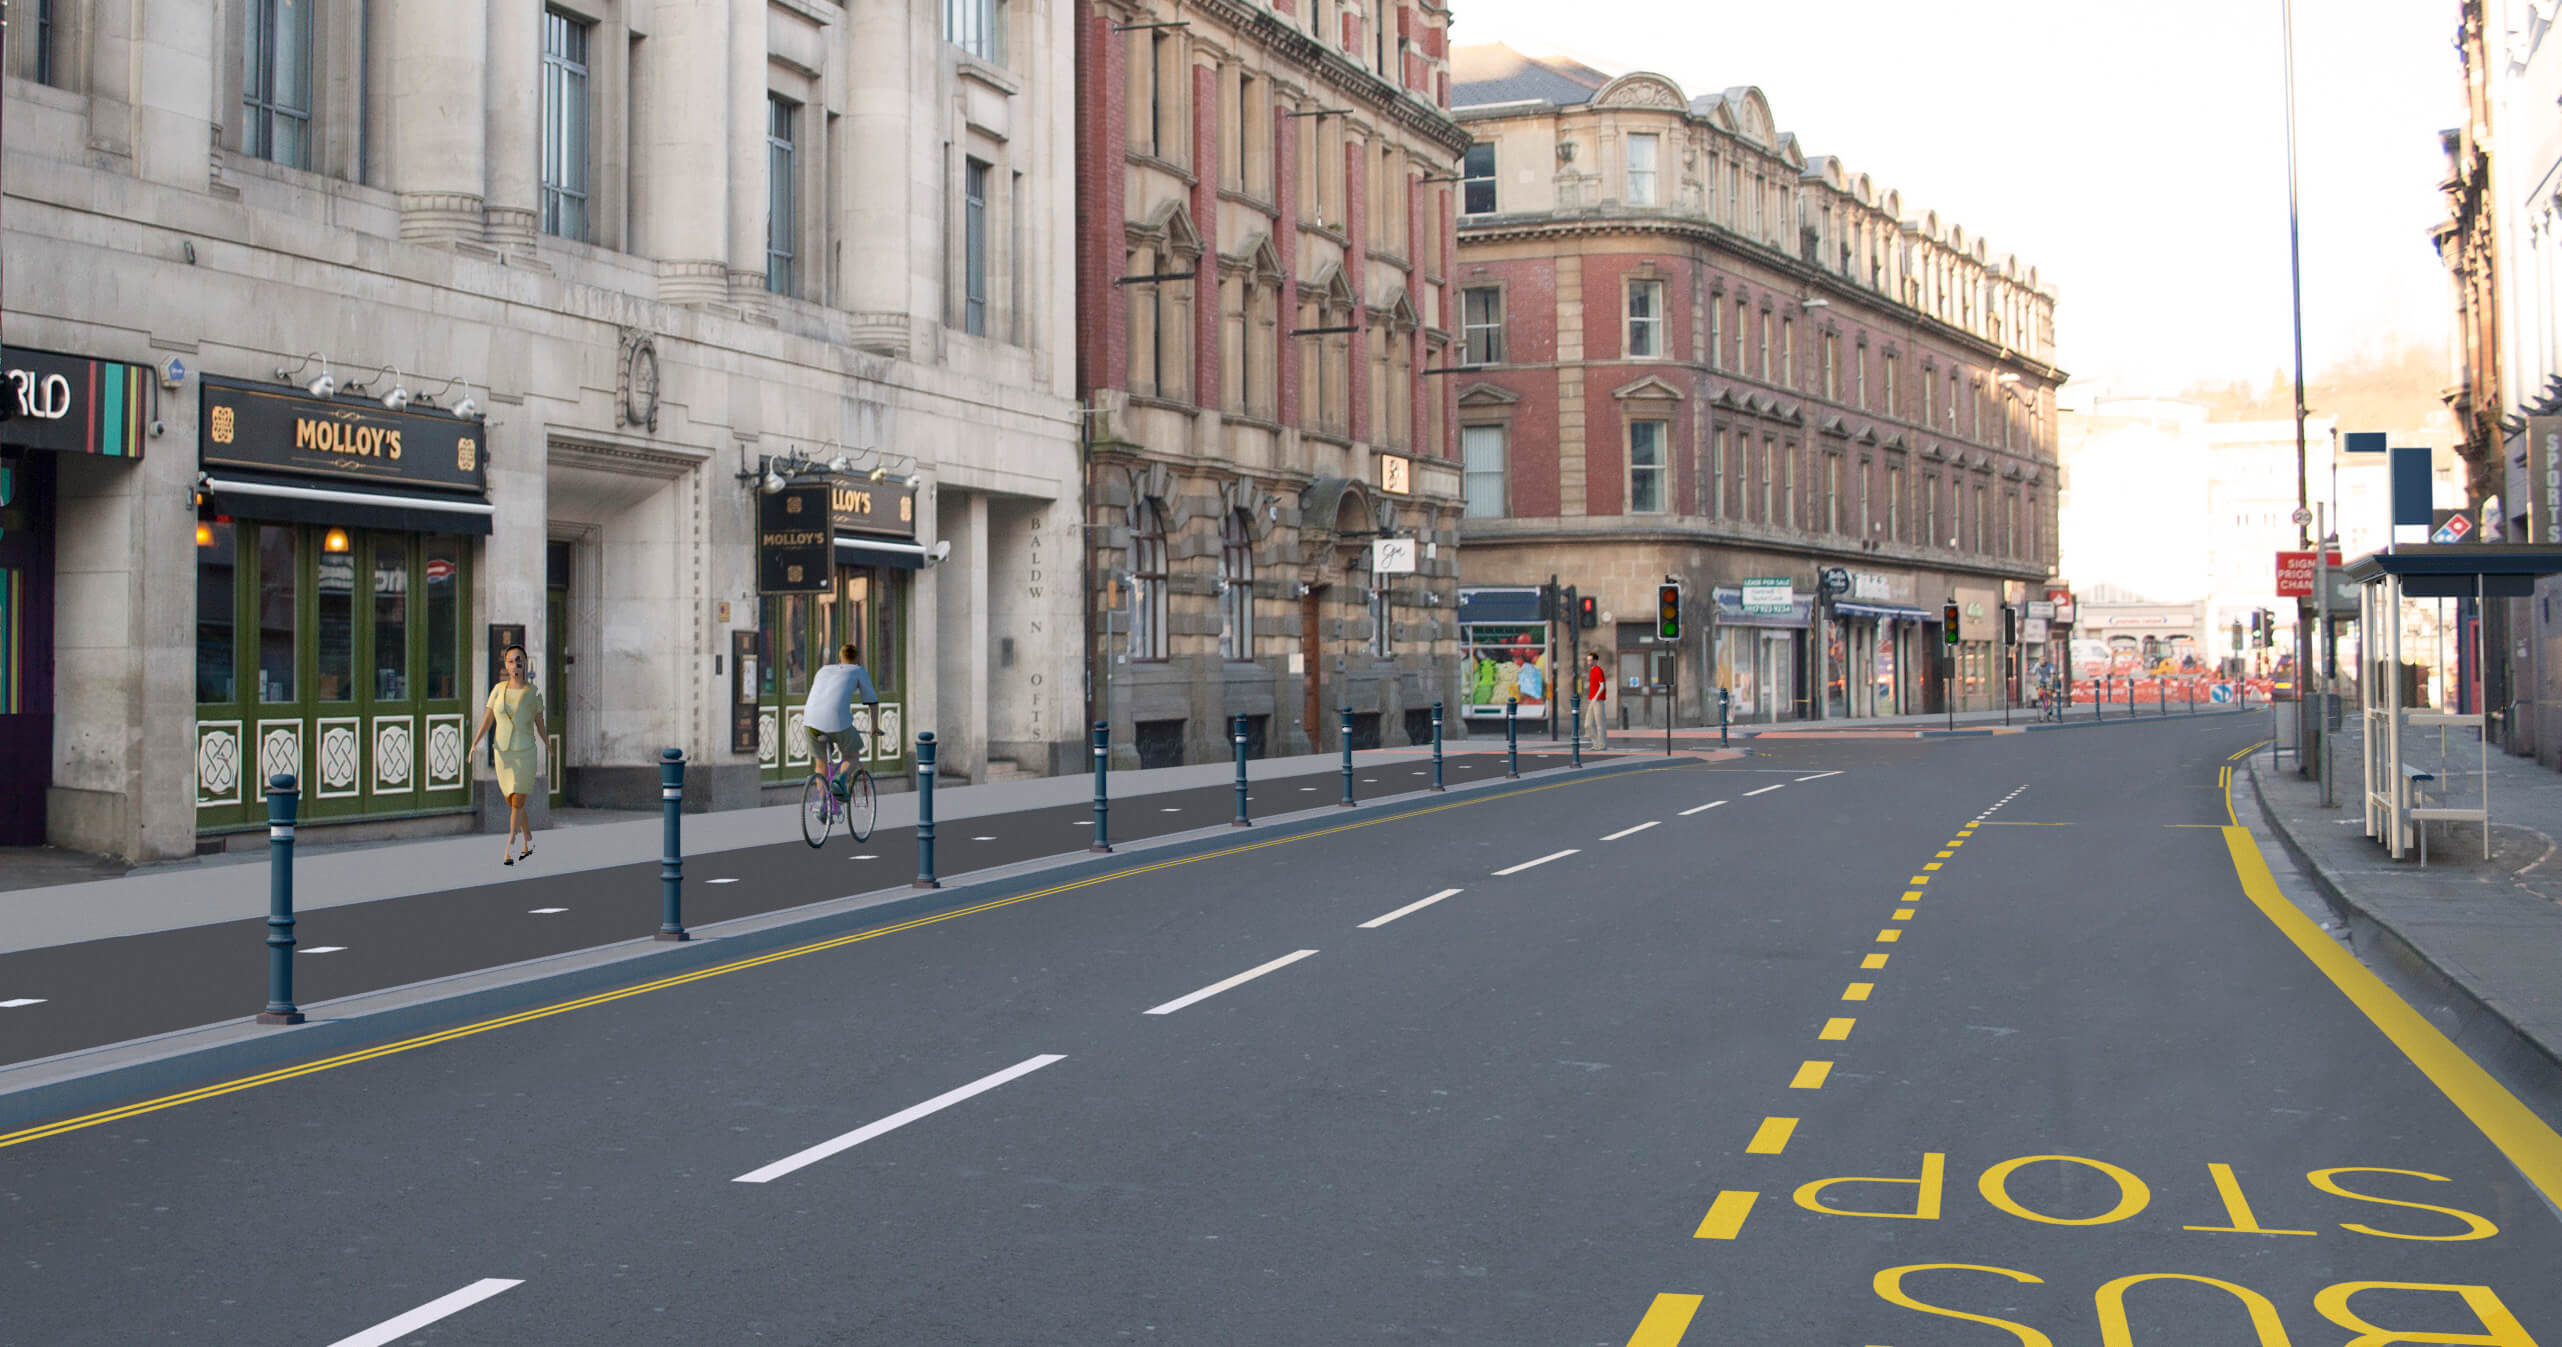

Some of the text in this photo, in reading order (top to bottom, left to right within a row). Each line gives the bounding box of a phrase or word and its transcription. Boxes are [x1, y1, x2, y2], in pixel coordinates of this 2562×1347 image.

[9, 369, 71, 419] RLD
[296, 417, 402, 460] MOLLOY'S
[832, 488, 871, 514] LLOY'S
[2546, 433, 2561, 543] SPORTS
[763, 532, 825, 546] MOLLOY'S
[1029, 518, 1043, 633] BALDWN
[2278, 569, 2312, 579] PRIOR
[2281, 580, 2313, 590] CHAN
[2288, 559, 2317, 569] SIGN
[1030, 673, 1043, 739] OFTS
[1792, 1153, 2499, 1241] STOP
[1864, 1263, 2539, 1347] BUS
